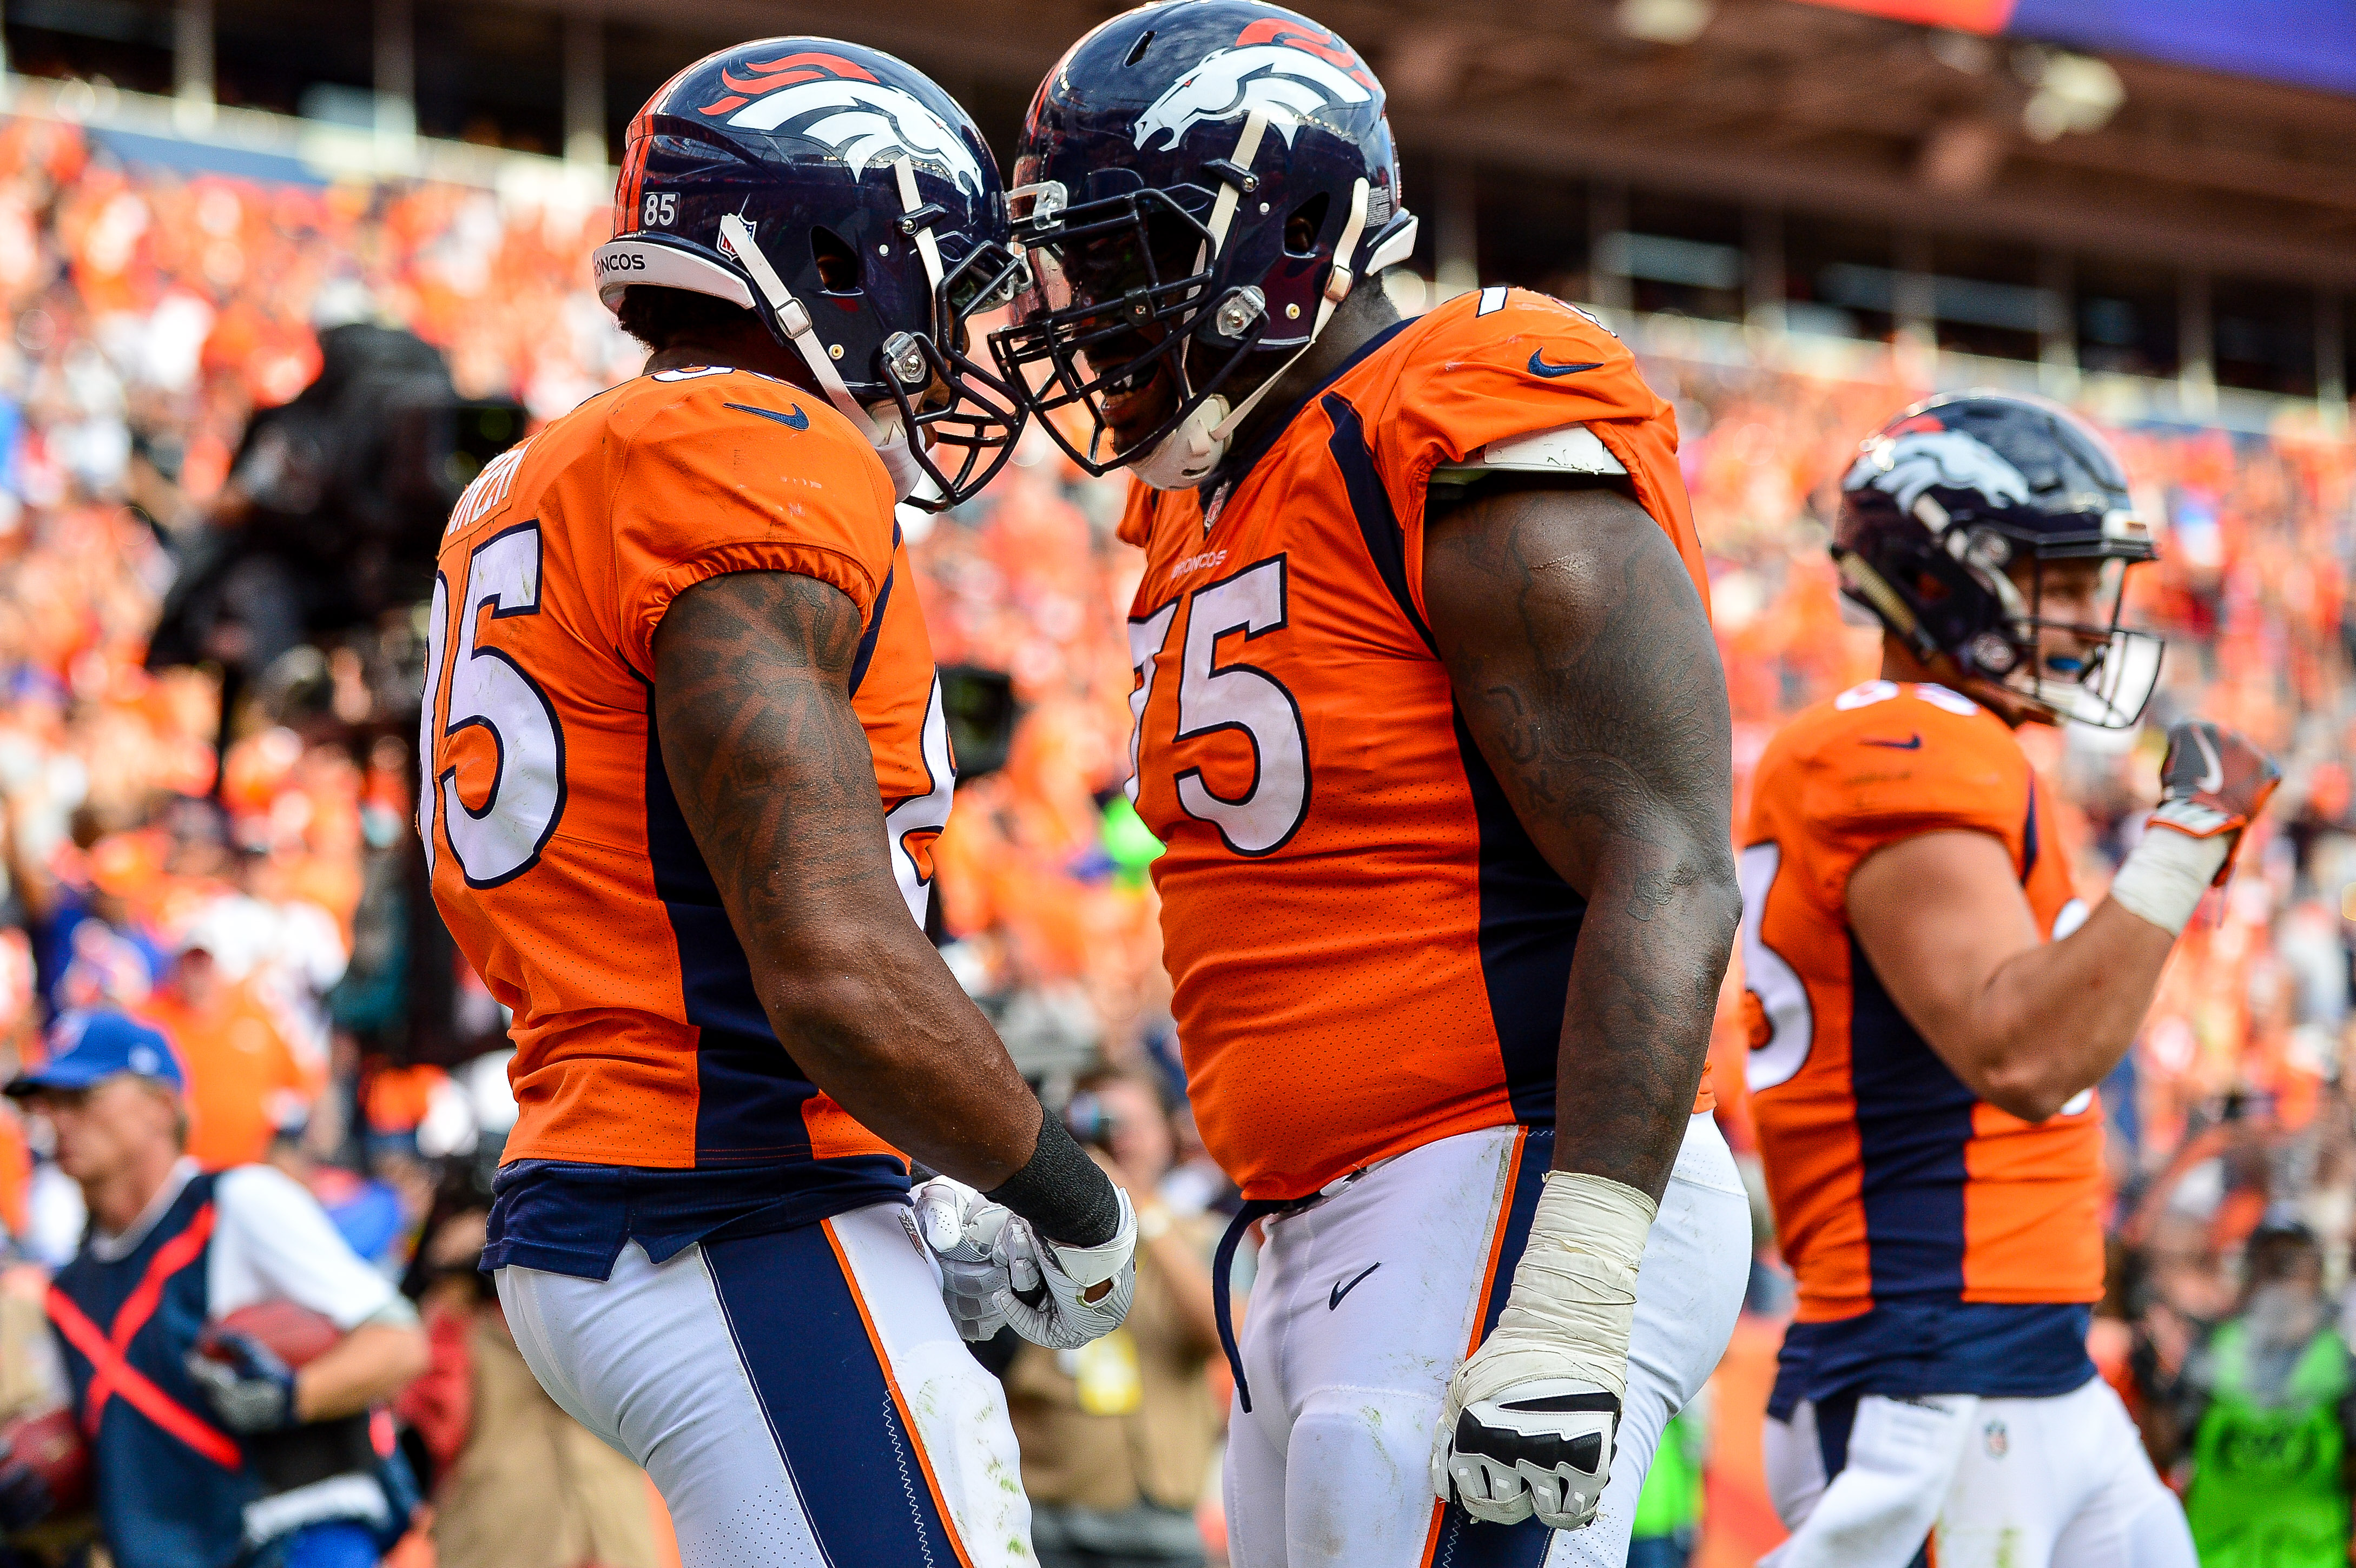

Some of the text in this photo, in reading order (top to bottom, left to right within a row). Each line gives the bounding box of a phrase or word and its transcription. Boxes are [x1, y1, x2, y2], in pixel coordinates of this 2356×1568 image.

[644, 194, 675, 226] 85
[595, 253, 646, 278] ONCOS
[1171, 549, 1228, 580] BRONCOS
[1124, 551, 1311, 856] 75
